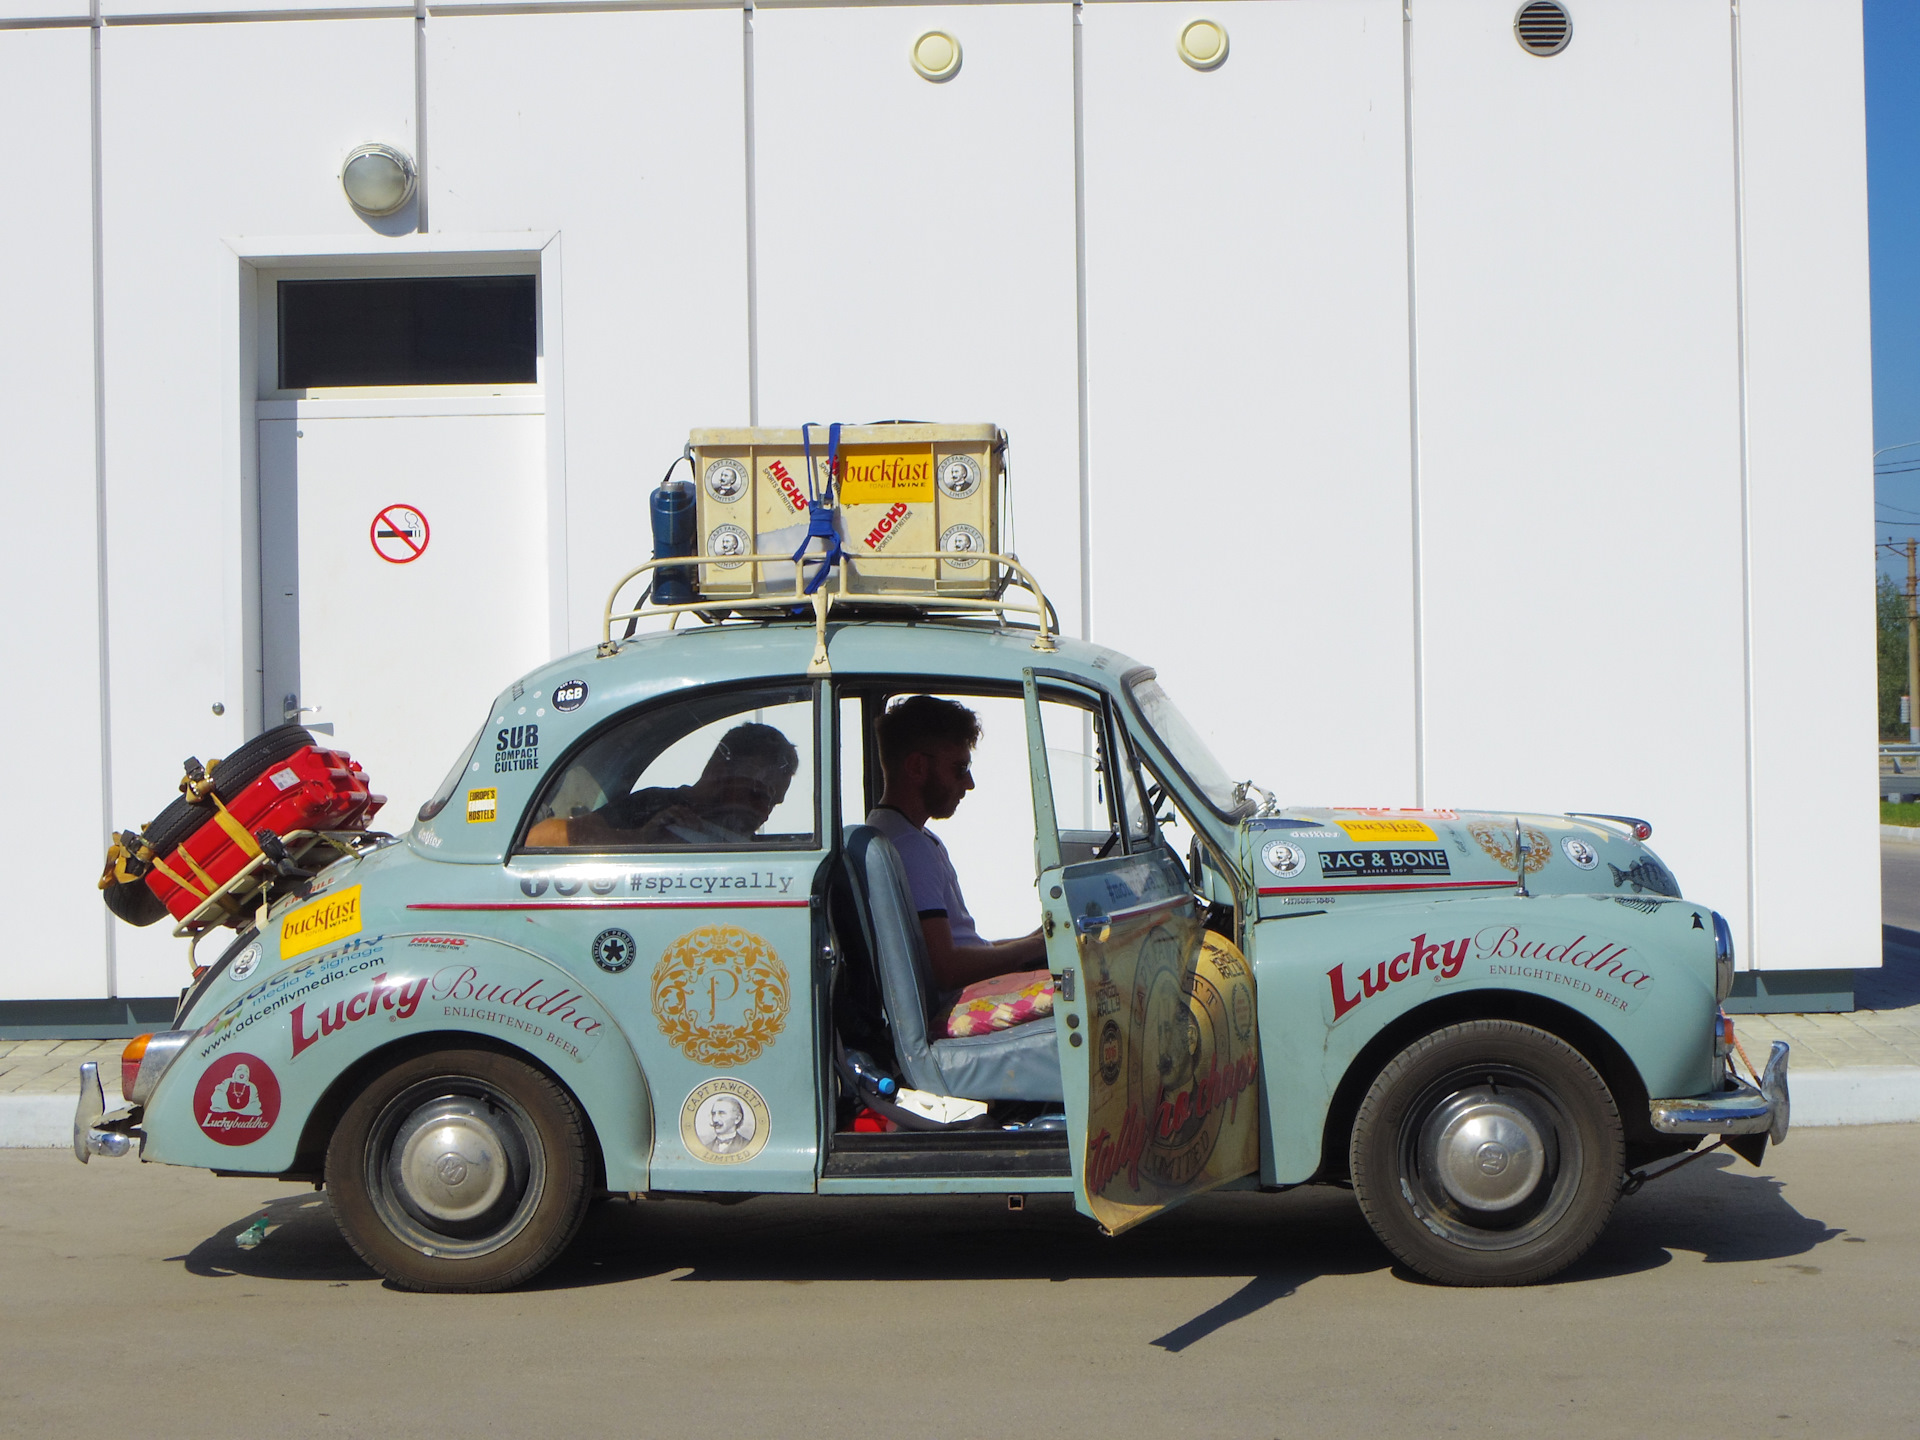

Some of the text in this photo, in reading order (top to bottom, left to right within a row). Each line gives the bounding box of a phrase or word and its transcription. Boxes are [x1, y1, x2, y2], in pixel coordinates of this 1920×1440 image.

[725, 460, 747, 478] FAWCETT
[844, 457, 929, 488] buckfast
[712, 493, 736, 502] LIMITED
[763, 467, 796, 515] SPORTS NUTRITION
[769, 460, 809, 511] HIGH5
[949, 488, 973, 498] LIMITED
[864, 503, 908, 549] HIGH5
[875, 510, 913, 552] SPORTS NUTRITION
[557, 687, 583, 702] R&B
[496, 724, 538, 751] SUB
[494, 758, 539, 773] CULTURE
[495, 748, 538, 762] COMPACT
[470, 790, 495, 801] EUROPE'S
[469, 810, 494, 820] HOSTELS
[1320, 852, 1448, 868] RAG & BONE
[630, 872, 793, 894] #spicyrally
[284, 898, 356, 939] buckfast
[330, 916, 354, 928] WINE
[252, 946, 384, 1007] media & signage
[1326, 924, 1652, 1023] Lucky Buddha
[1490, 964, 1628, 1012] ENLIGHTENED BEER
[201, 958, 384, 1058] www.adcentivmedia.com
[289, 964, 602, 1060] Lucky Buddha
[1097, 996, 1121, 1017] RALLY
[444, 1006, 580, 1058] ENLIGHTENED BEER
[687, 1082, 762, 1112] CAPT FAWCETT
[703, 1150, 750, 1162] LIMITED
[1145, 1131, 1210, 1181] LIMITED
